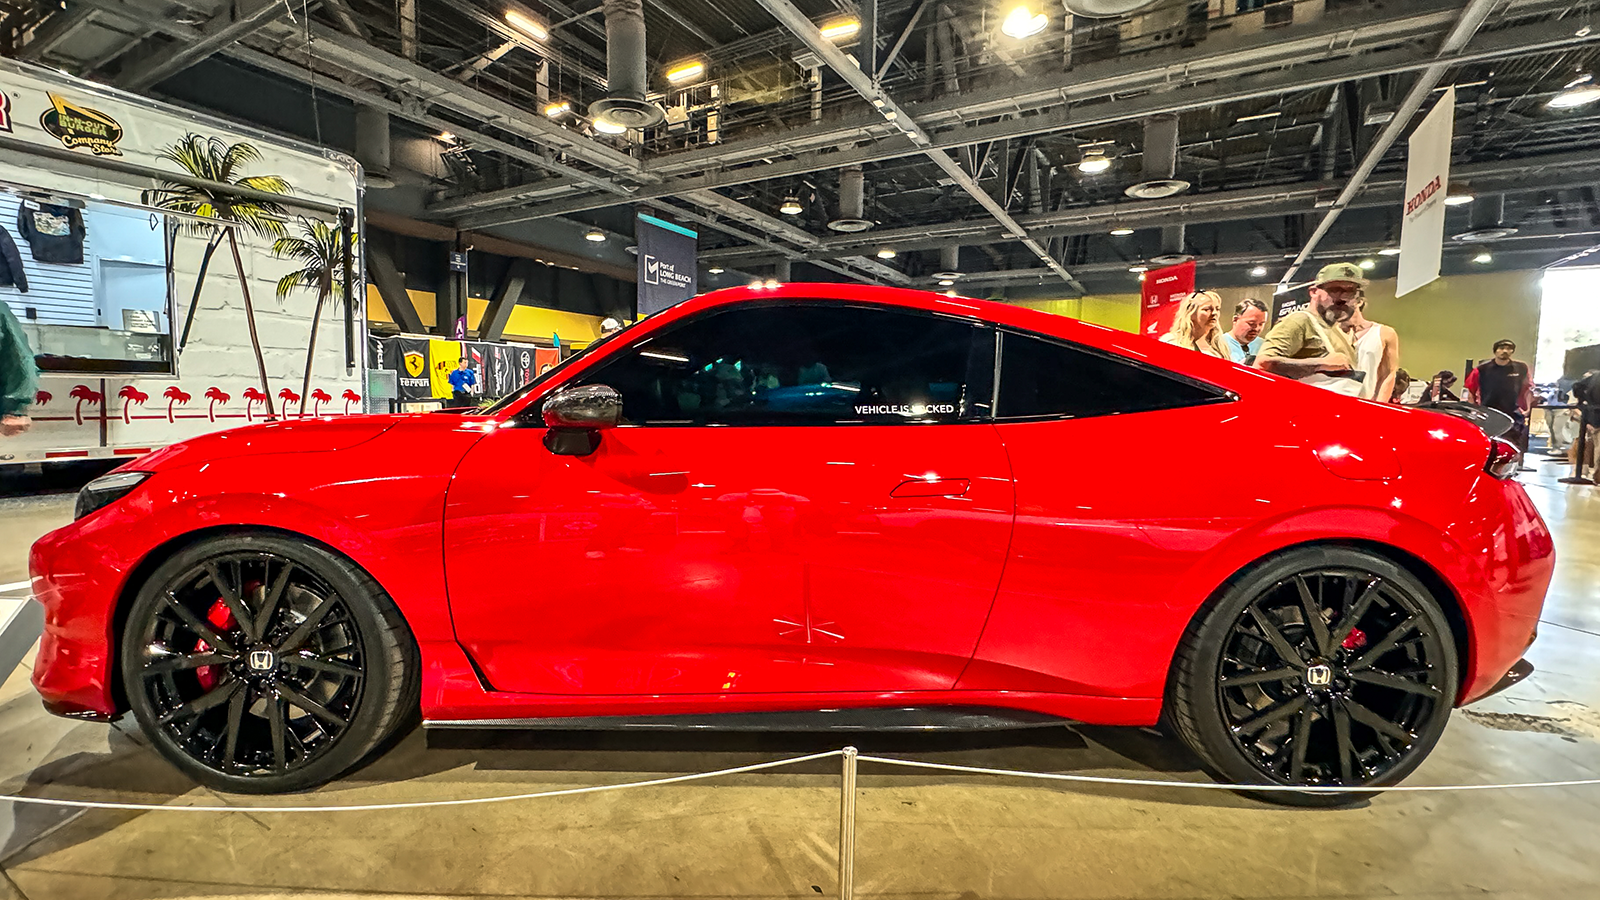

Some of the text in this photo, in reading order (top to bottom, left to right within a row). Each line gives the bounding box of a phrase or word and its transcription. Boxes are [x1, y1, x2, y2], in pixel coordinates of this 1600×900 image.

[59, 114, 107, 130] IN-N-OUT
[59, 120, 109, 138] BURGER
[61, 135, 114, 148] Company
[1406, 175, 1441, 216] HONDA
[660, 270, 692, 283] LONG BEACH
[1156, 276, 1178, 284] HONDA
[376, 340, 384, 370] McLa
[399, 377, 430, 388] Ferrari
[854, 405, 898, 415] VEHICLE
[899, 405, 909, 414] IS
